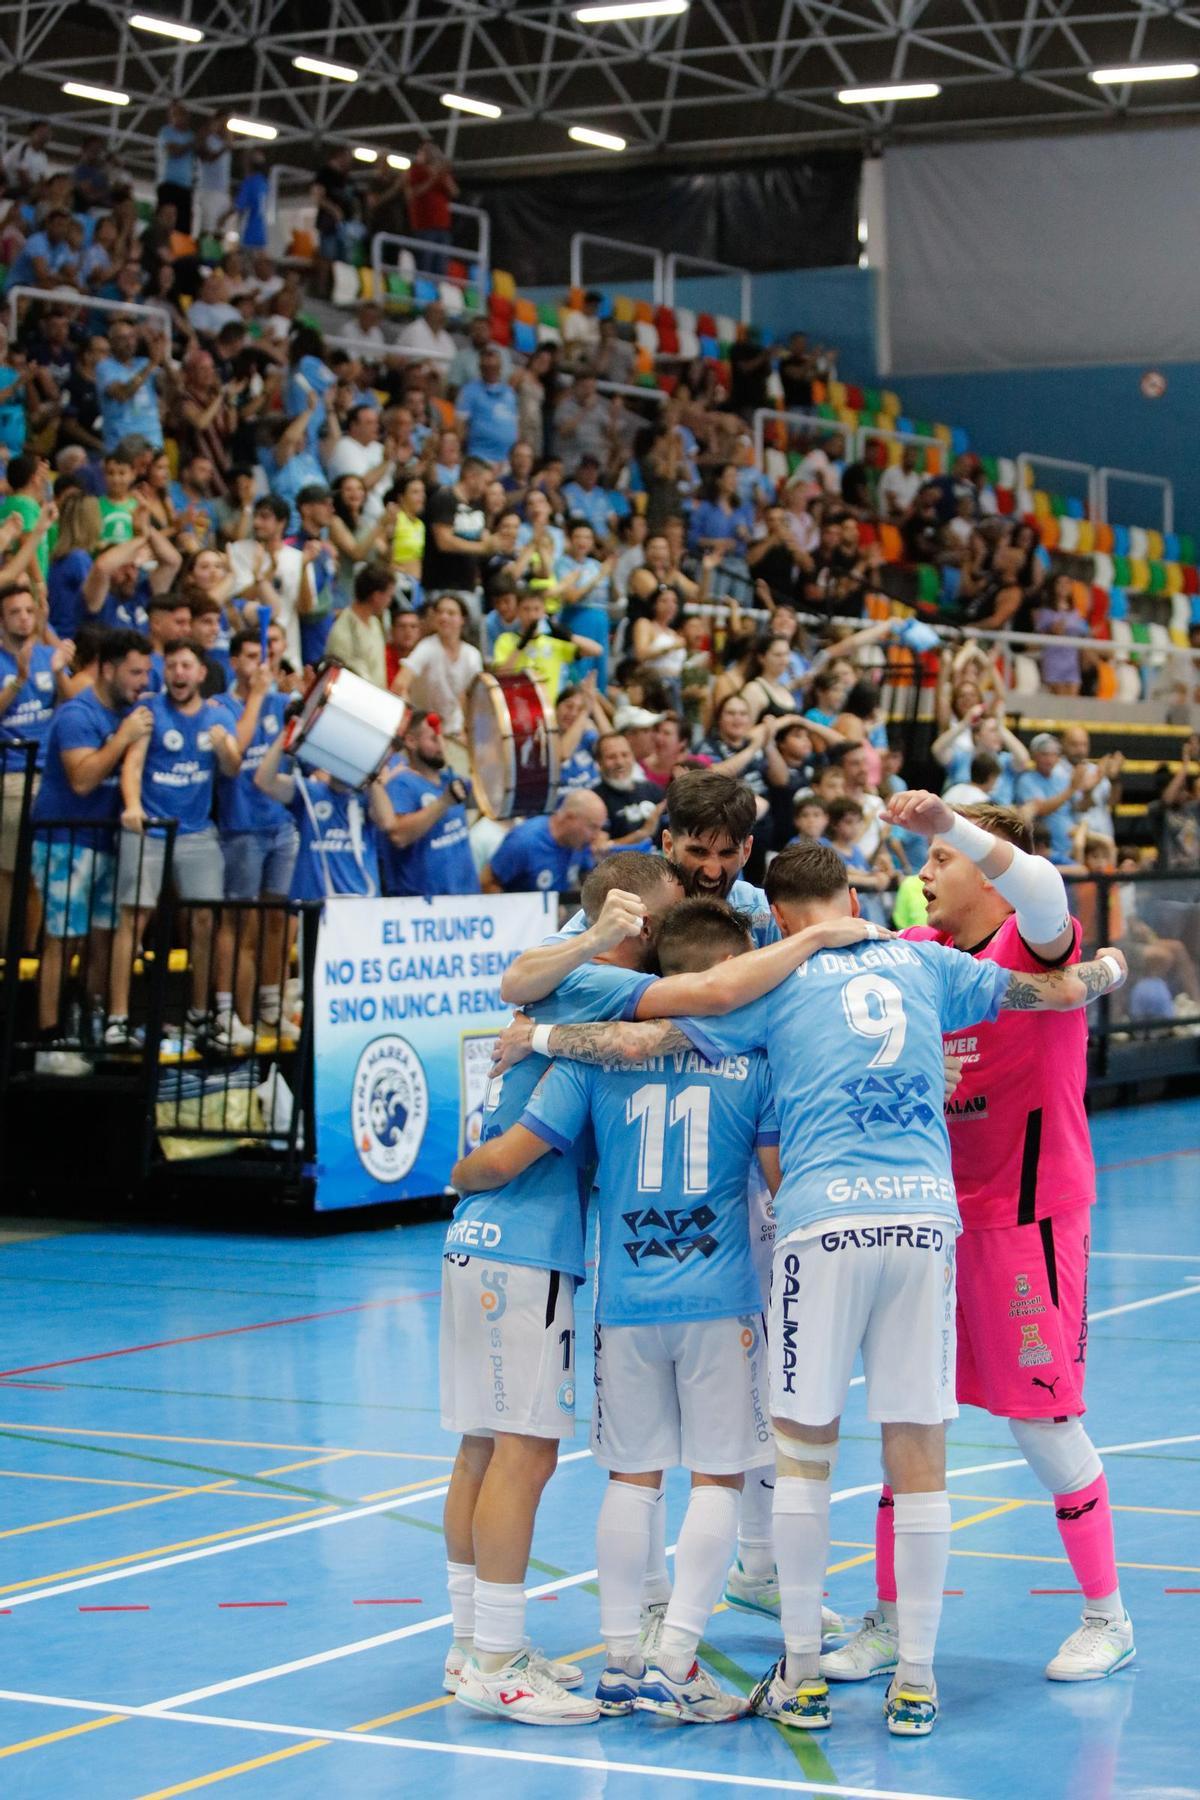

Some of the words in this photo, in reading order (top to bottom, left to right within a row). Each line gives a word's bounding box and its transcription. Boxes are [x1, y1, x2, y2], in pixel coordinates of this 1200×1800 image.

[382, 920, 405, 945] EL
[411, 916, 494, 942] TRIUNFO
[325, 960, 354, 985] NO
[360, 959, 382, 983] ES
[388, 954, 464, 981] GANAR
[382, 993, 452, 1020] NUNCA
[841, 974, 907, 1068] 9
[943, 1037, 978, 1056] WER
[626, 1084, 711, 1195] 11
[826, 1175, 954, 1203] GASIFRE
[761, 1224, 777, 1232] Con
[821, 1225, 944, 1252] GASIFRED
